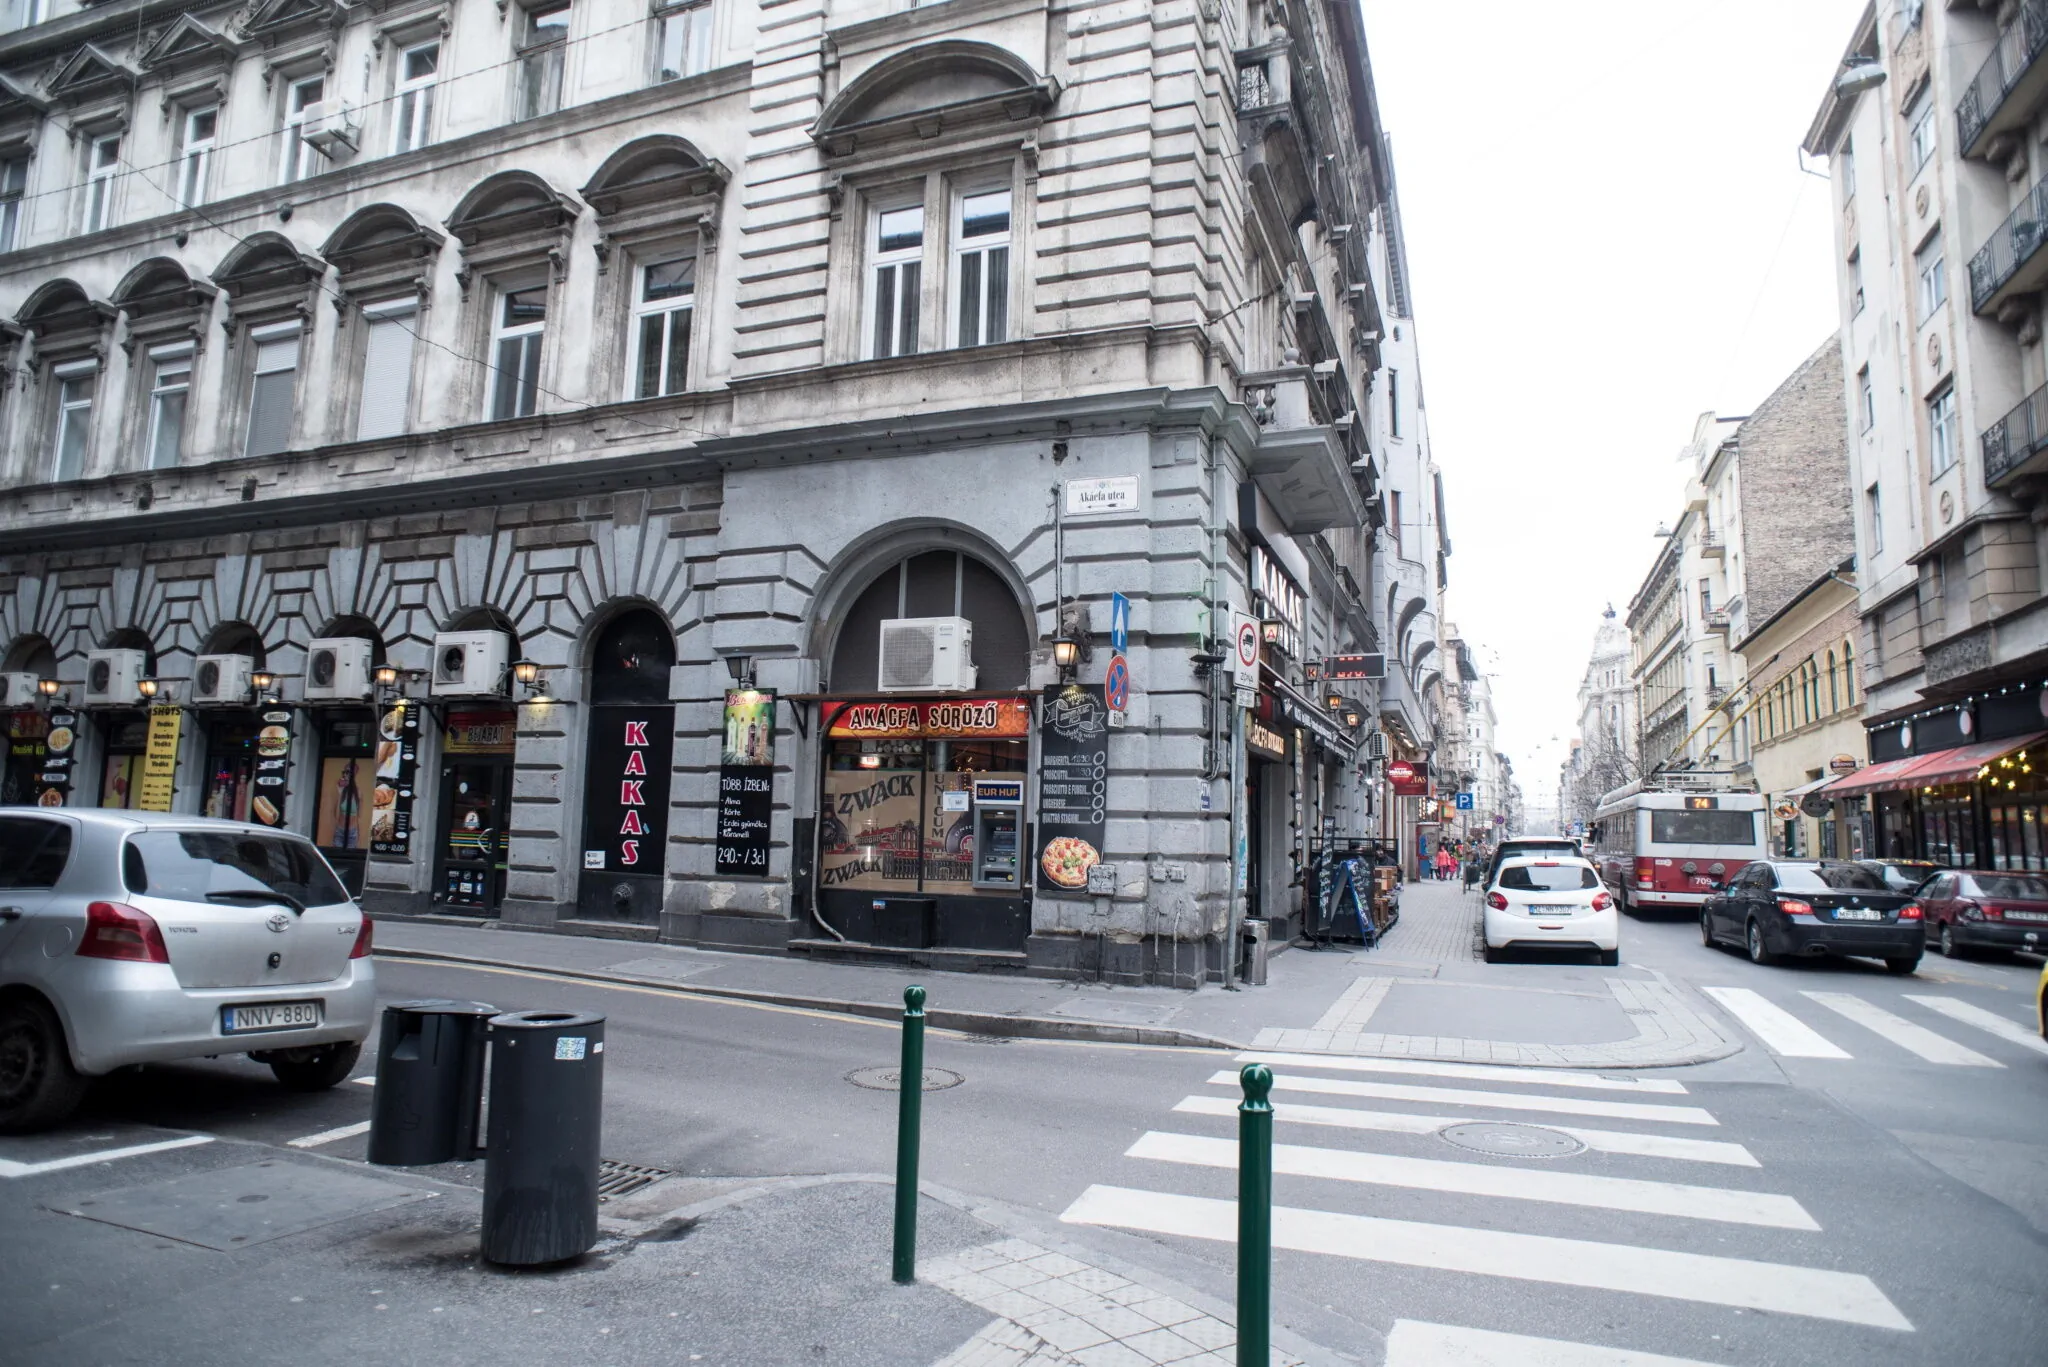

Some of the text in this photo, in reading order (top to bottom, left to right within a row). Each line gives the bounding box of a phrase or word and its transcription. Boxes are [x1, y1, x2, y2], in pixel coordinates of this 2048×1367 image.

[1080, 490, 1125, 502] Akácfa utca
[849, 701, 998, 731] AKÁCFA SÖRÖZŐ
[620, 722, 649, 864] KAKAS
[838, 775, 916, 816] ZWACK
[978, 787, 1019, 797] EUR HUF
[724, 796, 741, 805] Alma
[932, 774, 945, 838] UNICUM
[1459, 795, 1469, 808] P
[1694, 798, 1708, 808] 74
[723, 819, 740, 828] Erdei
[751, 848, 766, 865] 3cl
[823, 856, 882, 885] ZWACK
[1695, 877, 1712, 885] 709
[237, 1005, 313, 1027] NNV-880
